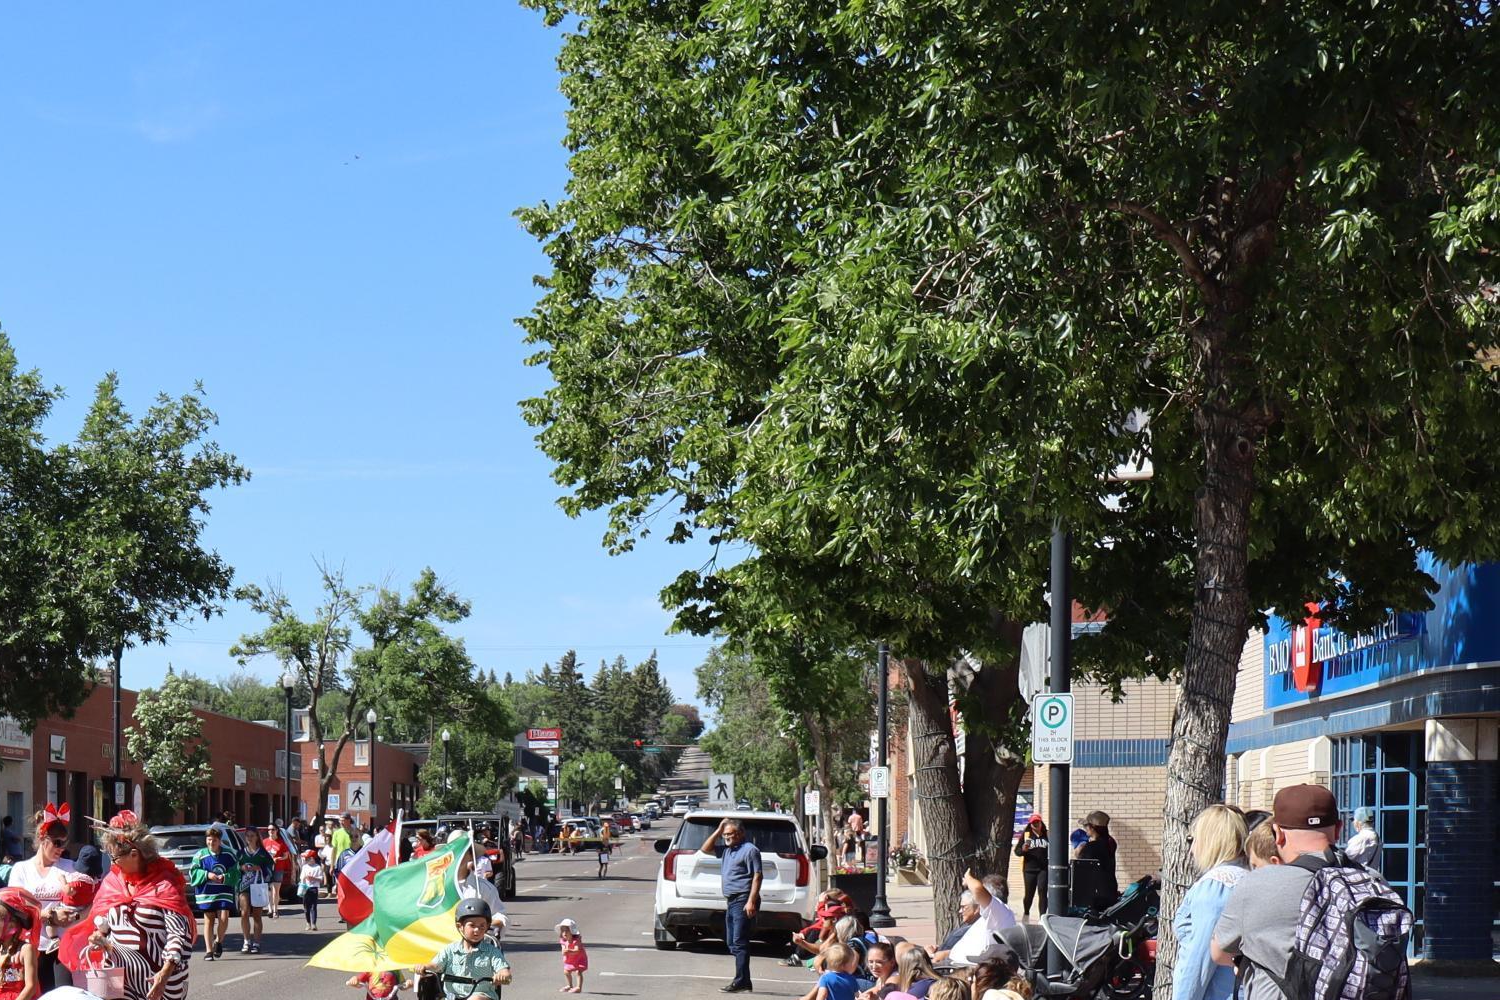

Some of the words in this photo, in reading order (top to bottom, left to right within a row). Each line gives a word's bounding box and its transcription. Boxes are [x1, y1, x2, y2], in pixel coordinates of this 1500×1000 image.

[1269, 639, 1290, 675] BMO
[1312, 627, 1335, 663] Bank
[1048, 705, 1059, 721] P
